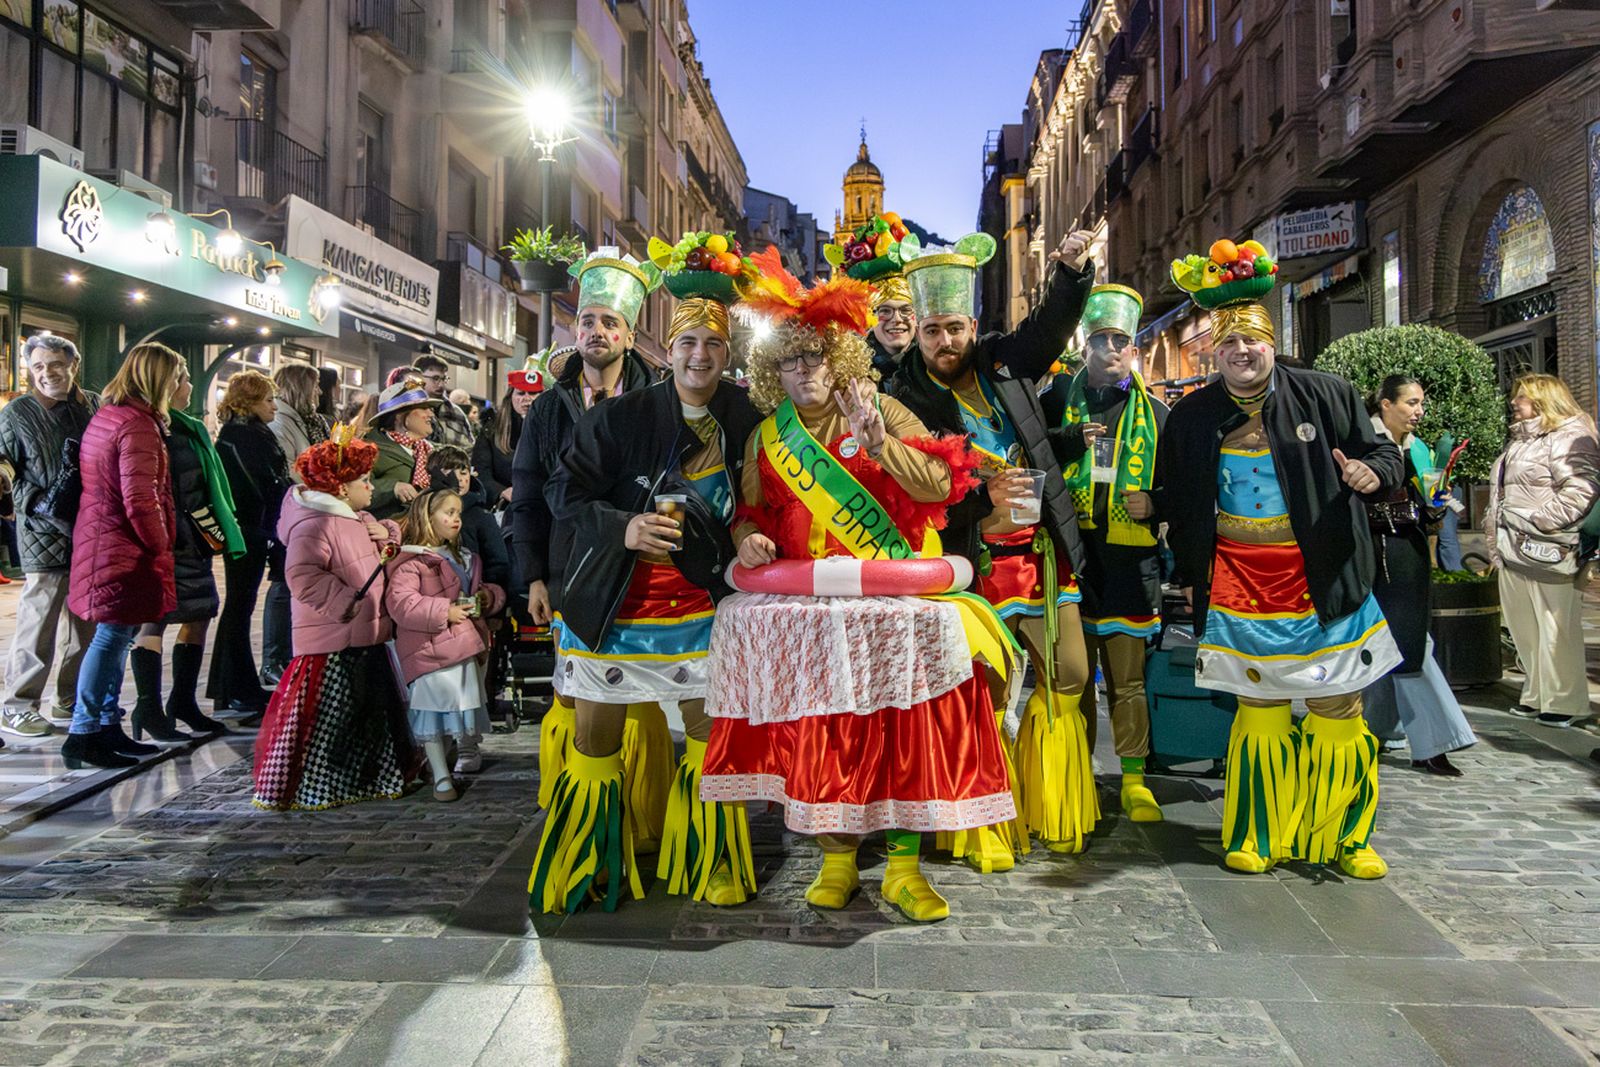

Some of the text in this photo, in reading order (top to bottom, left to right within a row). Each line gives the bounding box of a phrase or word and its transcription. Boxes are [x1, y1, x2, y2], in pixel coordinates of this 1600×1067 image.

[322, 239, 431, 308] MANGASVERDES
[1284, 229, 1349, 253] TOLEDANO
[770, 417, 830, 492] MISS
